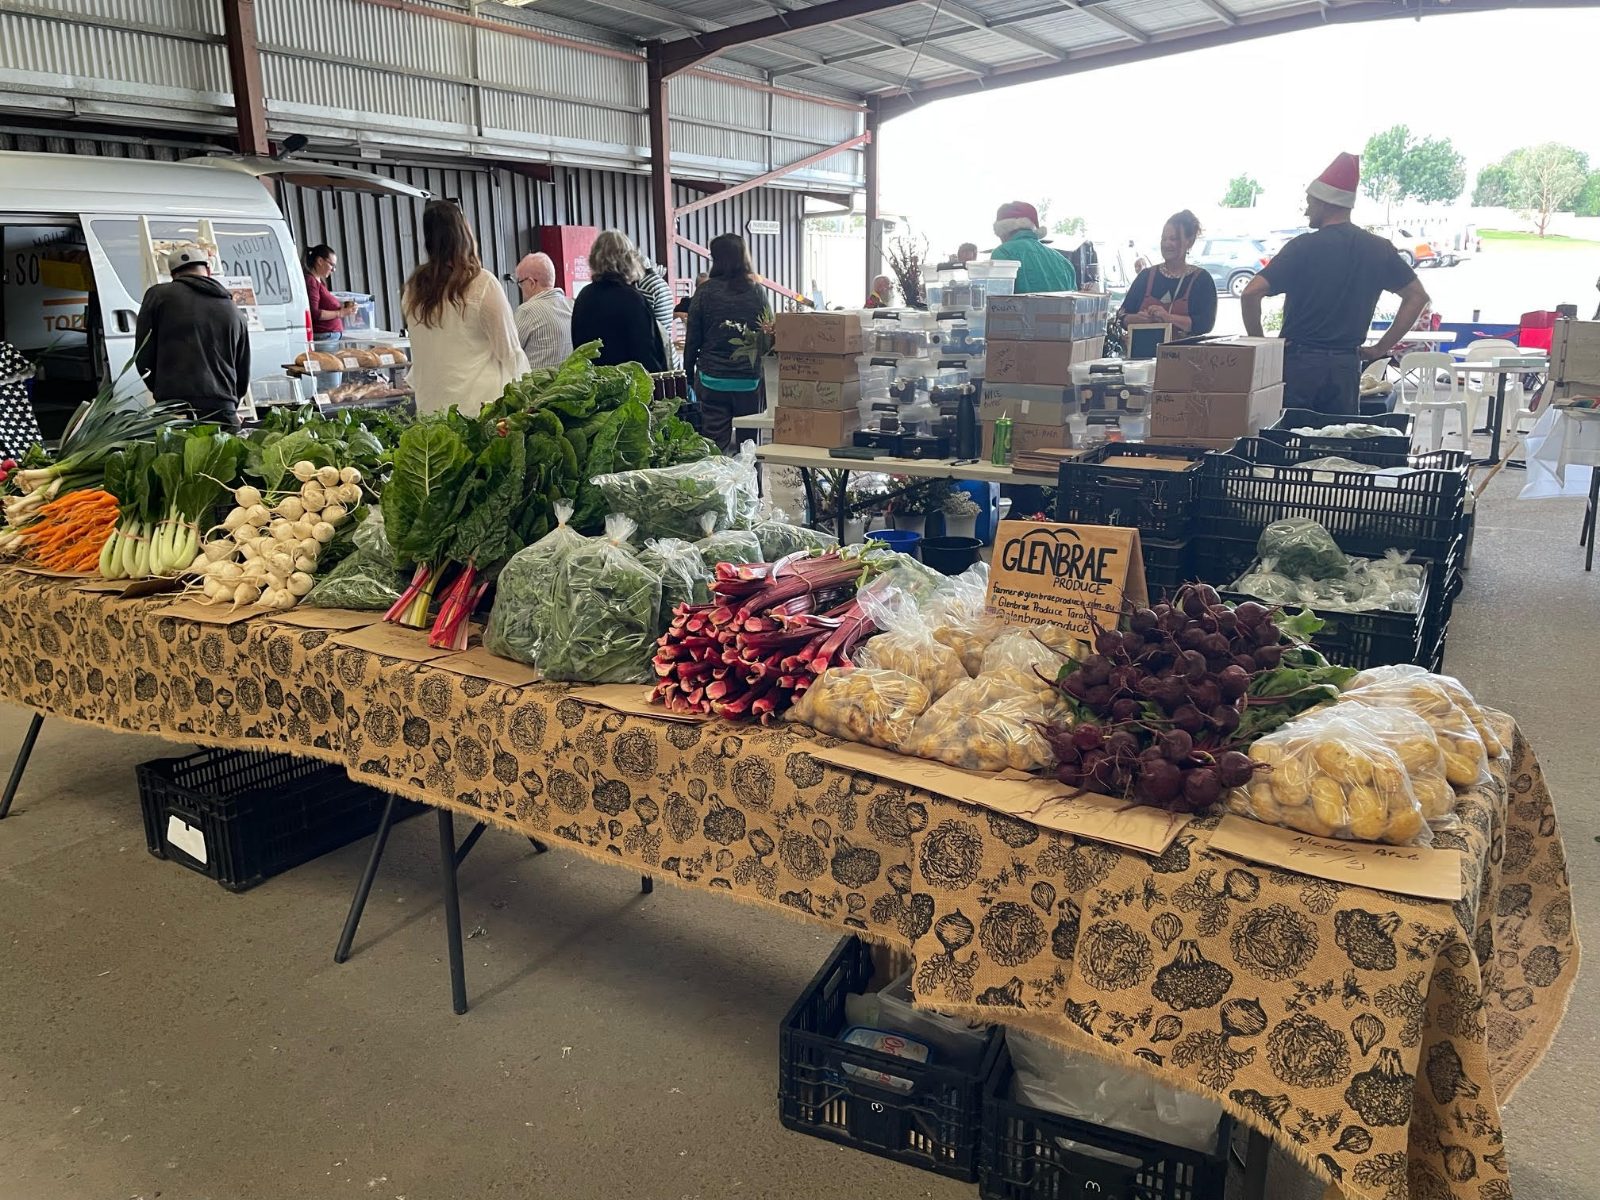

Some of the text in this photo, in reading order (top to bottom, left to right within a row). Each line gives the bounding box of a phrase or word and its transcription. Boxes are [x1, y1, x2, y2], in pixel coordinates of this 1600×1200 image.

[1002, 538, 1118, 584] GLENBRAE
[1053, 577, 1108, 596] PRODUCE
[998, 596, 1030, 611] Glenbrae
[1033, 602, 1063, 616] Produce
